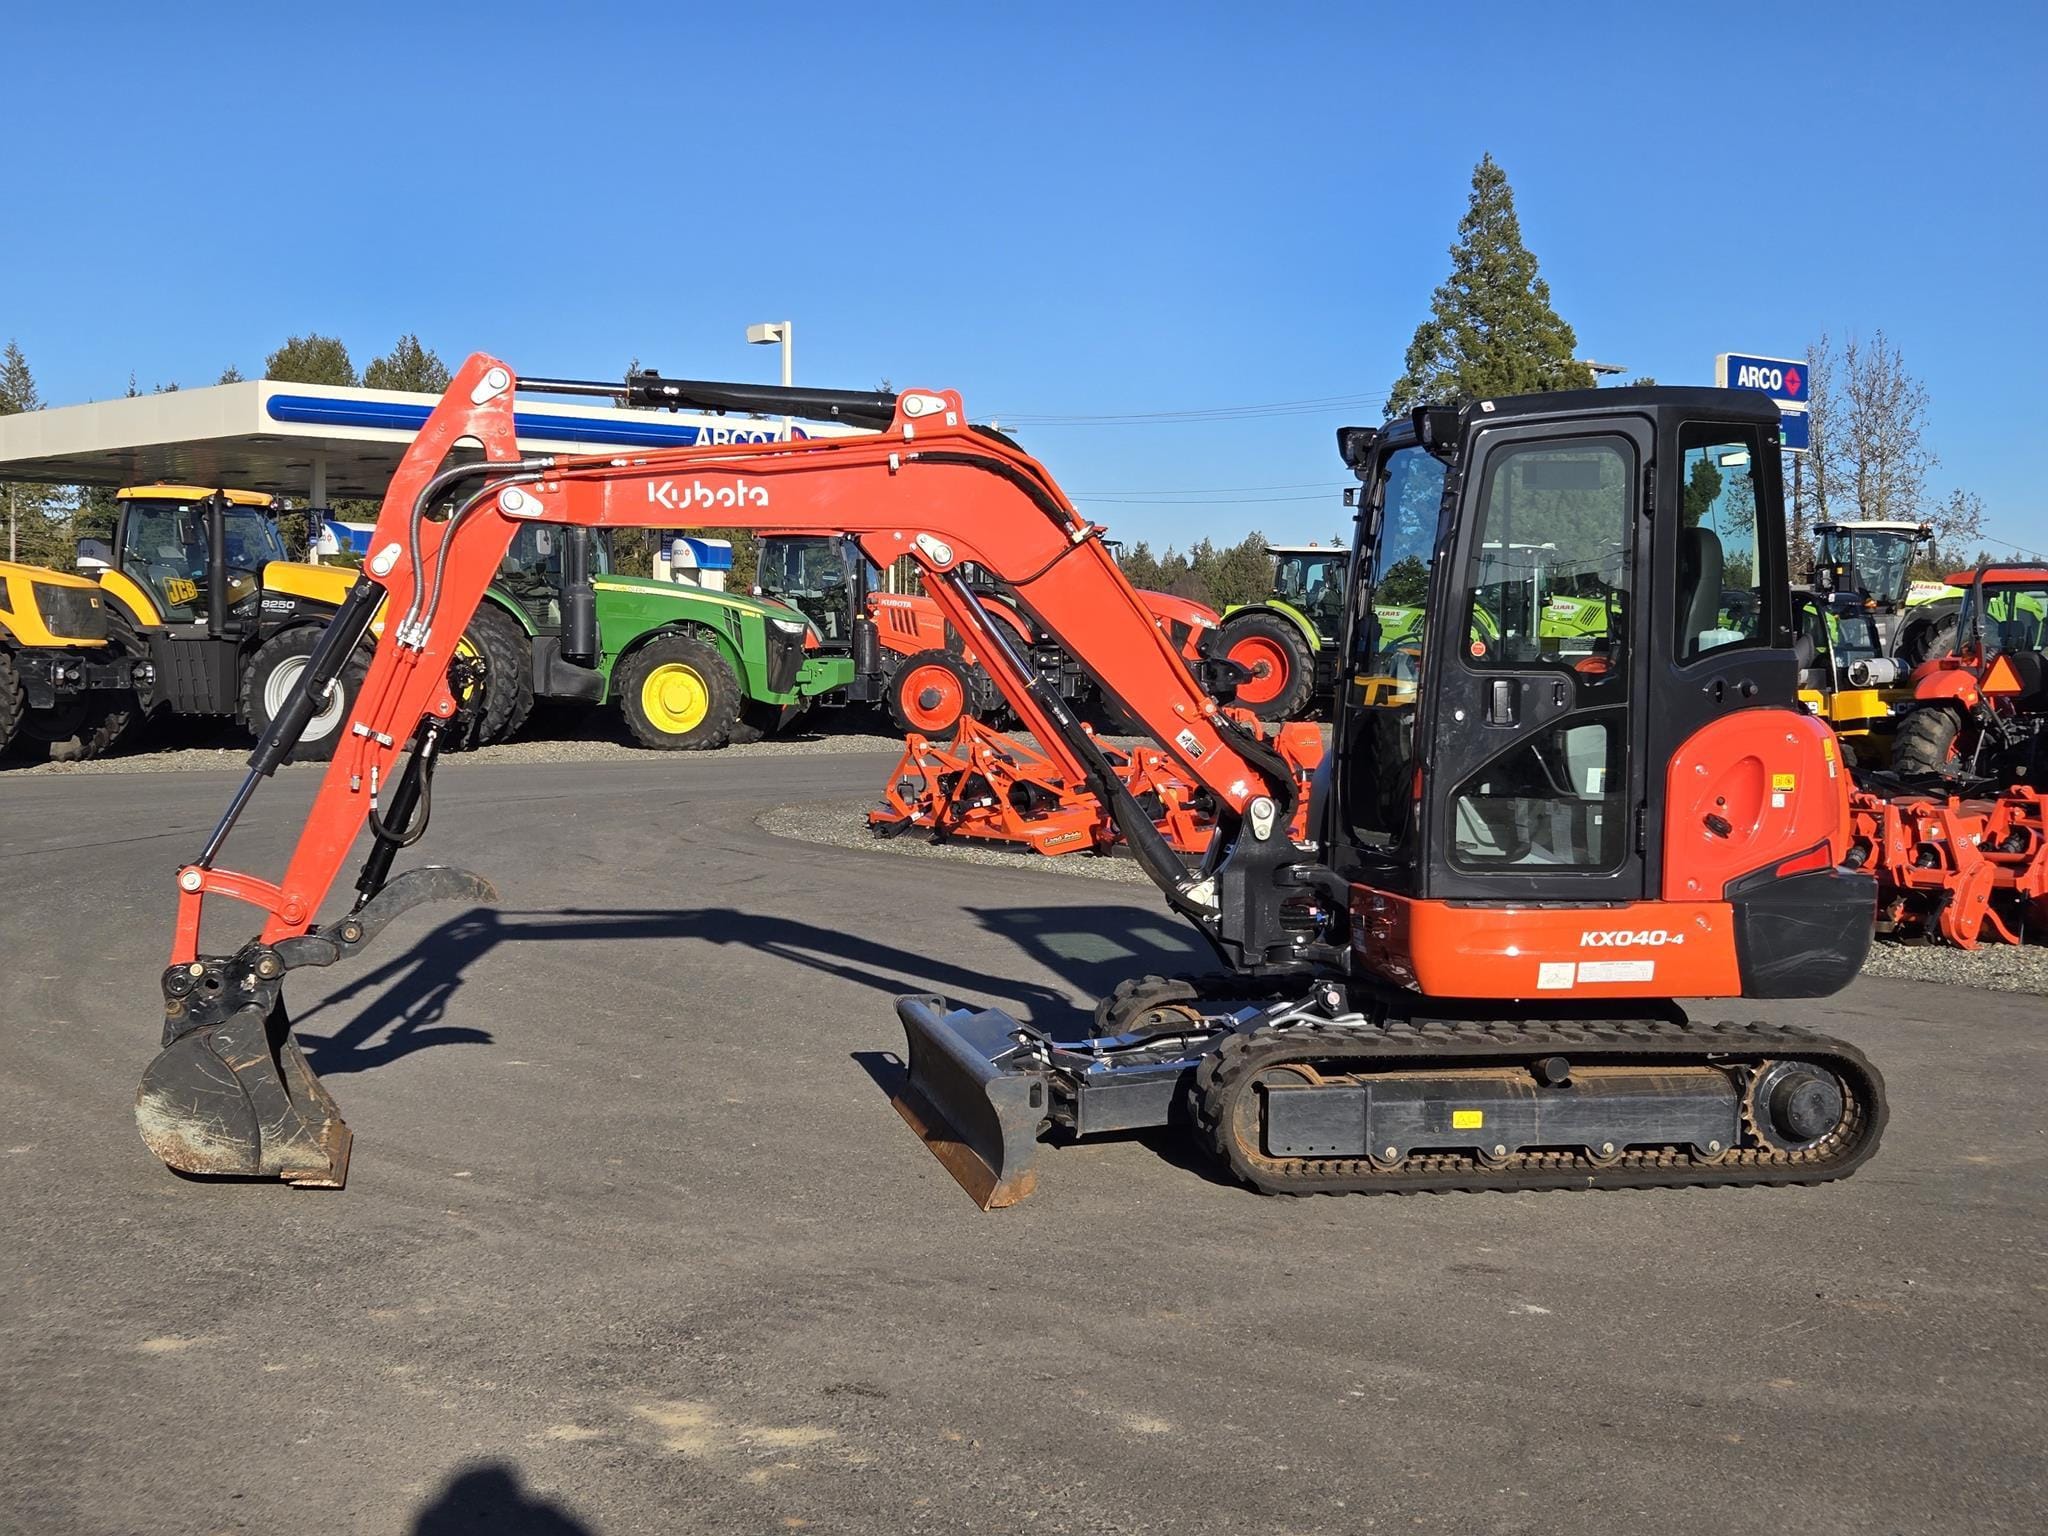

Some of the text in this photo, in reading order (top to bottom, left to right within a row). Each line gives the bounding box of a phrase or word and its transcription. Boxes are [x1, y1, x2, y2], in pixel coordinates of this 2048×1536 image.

[1737, 365, 1782, 391] ARCO
[647, 479, 769, 509] Kubota
[169, 580, 195, 603] JCB
[261, 600, 296, 609] 8250
[881, 599, 912, 608] KUBOTA
[1580, 930, 1685, 947] KX040-4
